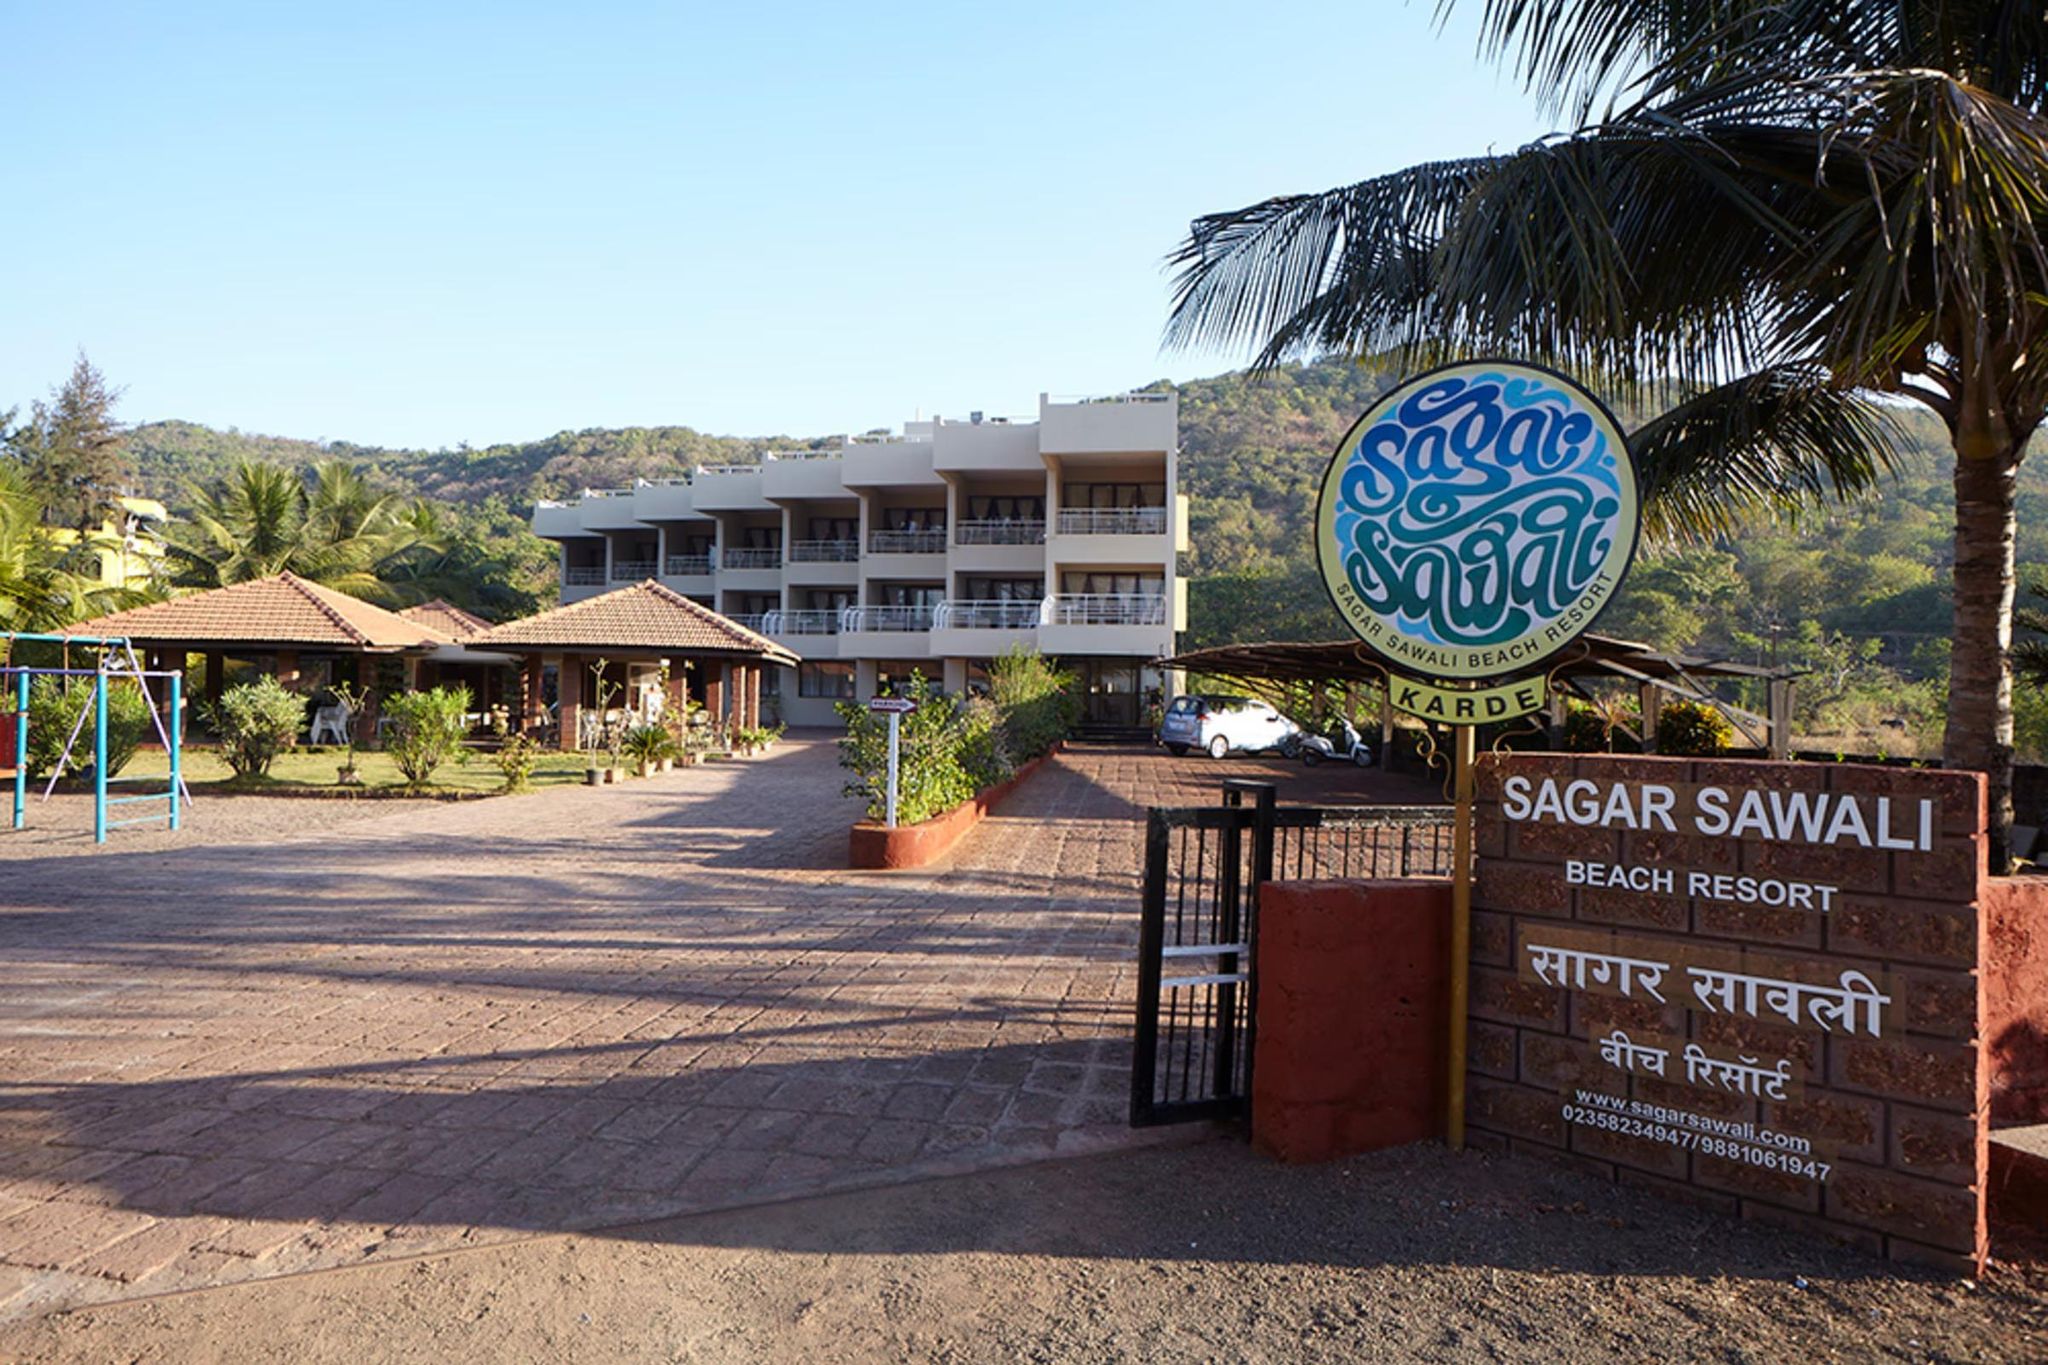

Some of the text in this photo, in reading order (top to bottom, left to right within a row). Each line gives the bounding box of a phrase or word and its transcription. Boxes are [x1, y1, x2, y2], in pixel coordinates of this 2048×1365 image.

[1341, 378, 1593, 524] Sagar
[1336, 571, 1612, 668] SAGAR SAWALI BEACH RESORT
[1398, 687, 1539, 717] KARDE
[1502, 776, 1933, 851] SAGAR SAWALI
[1565, 860, 1838, 912] BEACH RESORT
[1526, 944, 1891, 1038] सागर सावली
[1600, 1030, 1791, 1101] बीच रिसॉर्ट
[1575, 1088, 1812, 1154] www.sagarsawali.com
